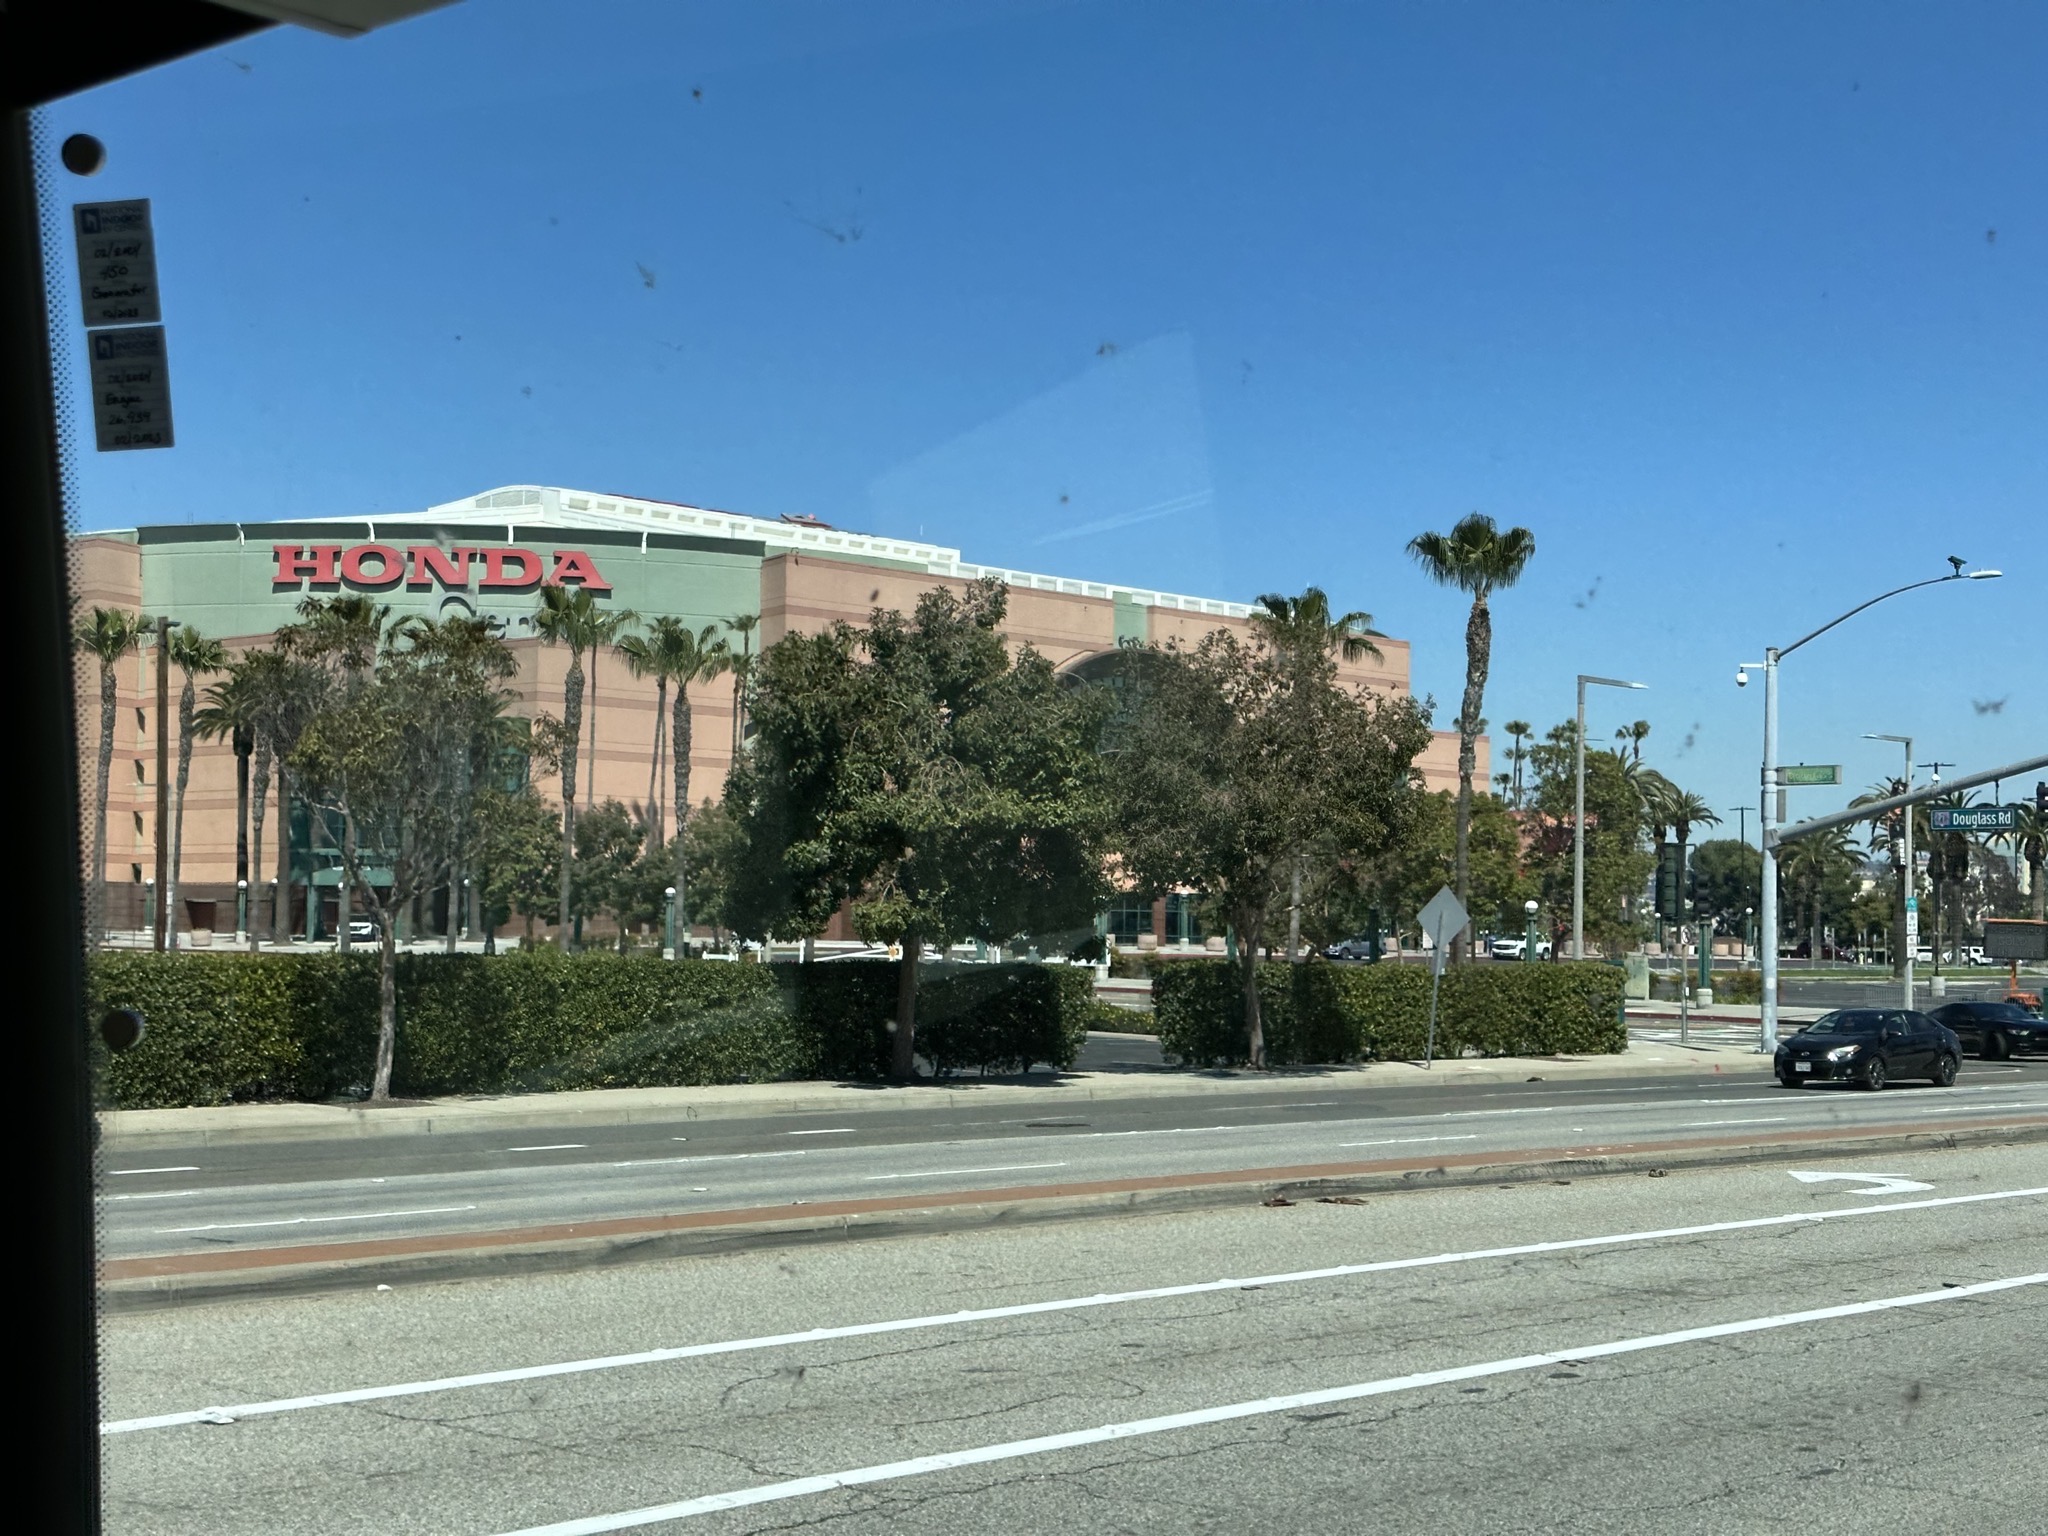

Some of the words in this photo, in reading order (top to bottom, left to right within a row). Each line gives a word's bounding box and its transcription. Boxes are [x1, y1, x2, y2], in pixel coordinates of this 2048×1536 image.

[272, 544, 613, 592] HONDA
[1953, 812, 1997, 828] Douglass
[1998, 811, 2011, 825] Rd
